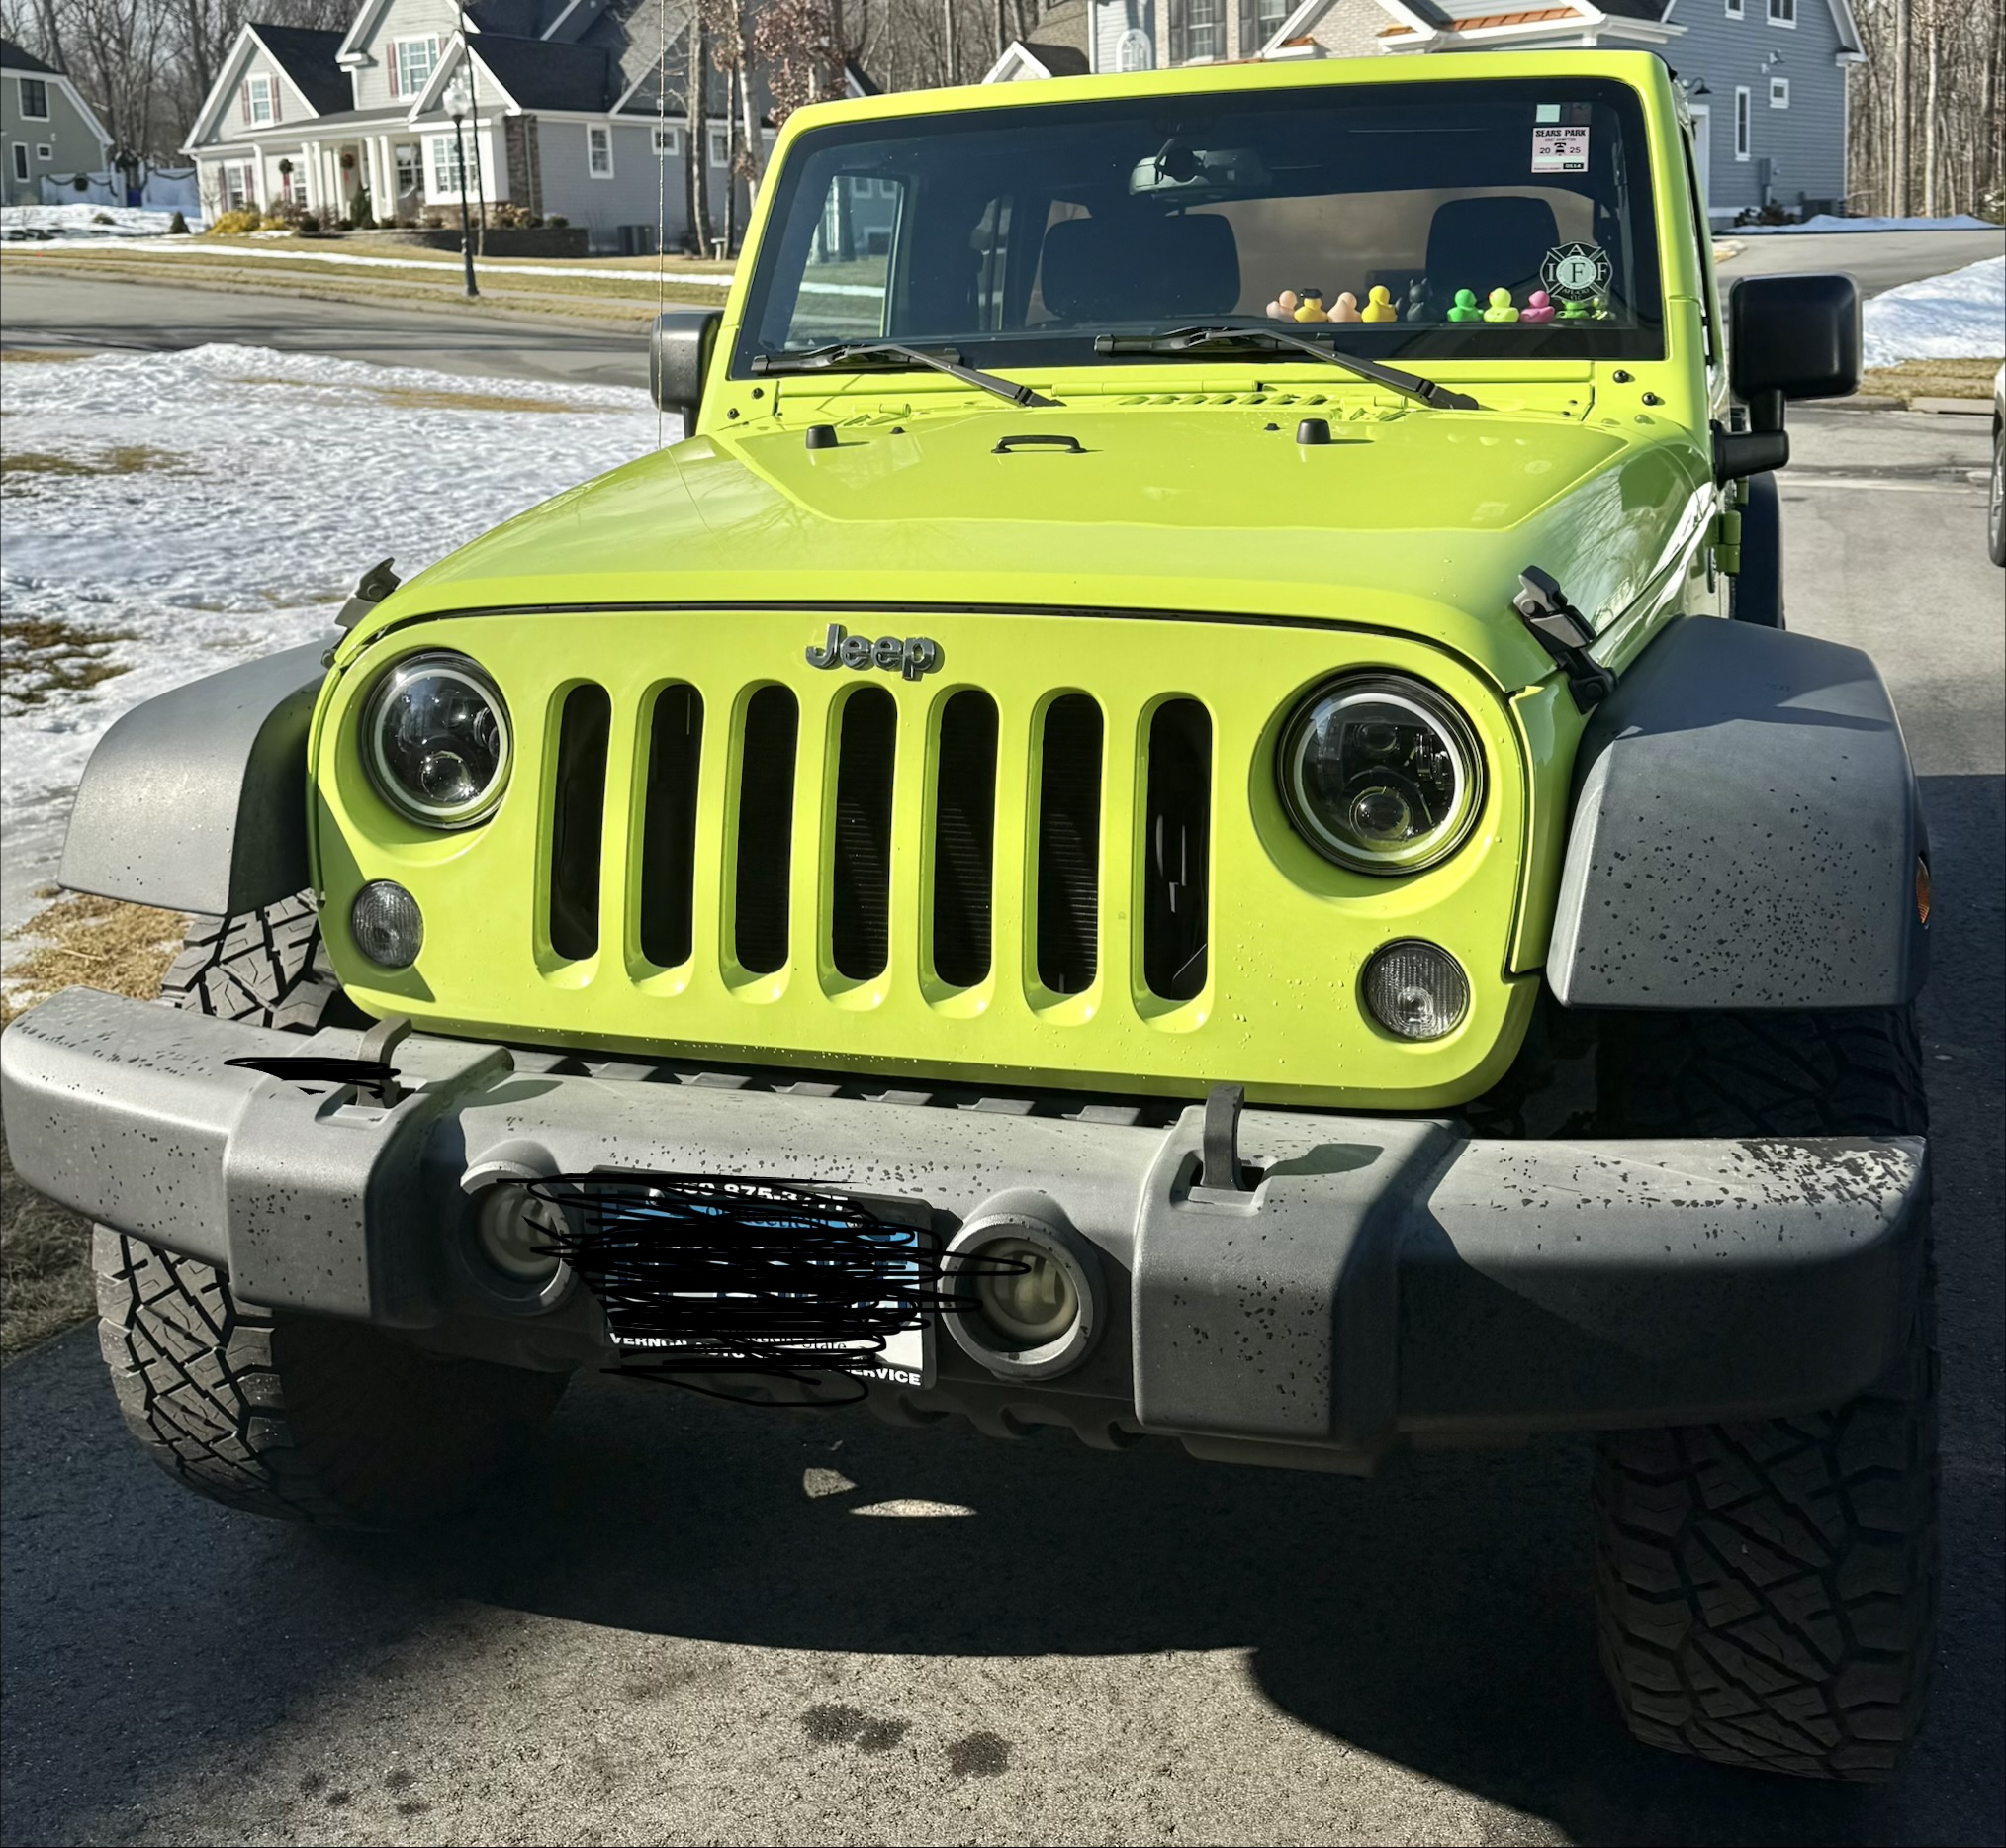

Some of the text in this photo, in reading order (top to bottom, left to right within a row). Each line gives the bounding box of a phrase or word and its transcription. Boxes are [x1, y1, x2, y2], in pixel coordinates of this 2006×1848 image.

[1535, 129, 1562, 138] SEARS
[1567, 244, 1586, 257] A
[1571, 262, 1586, 283] F
[1596, 262, 1608, 281] F
[805, 623, 938, 680] Jeep
